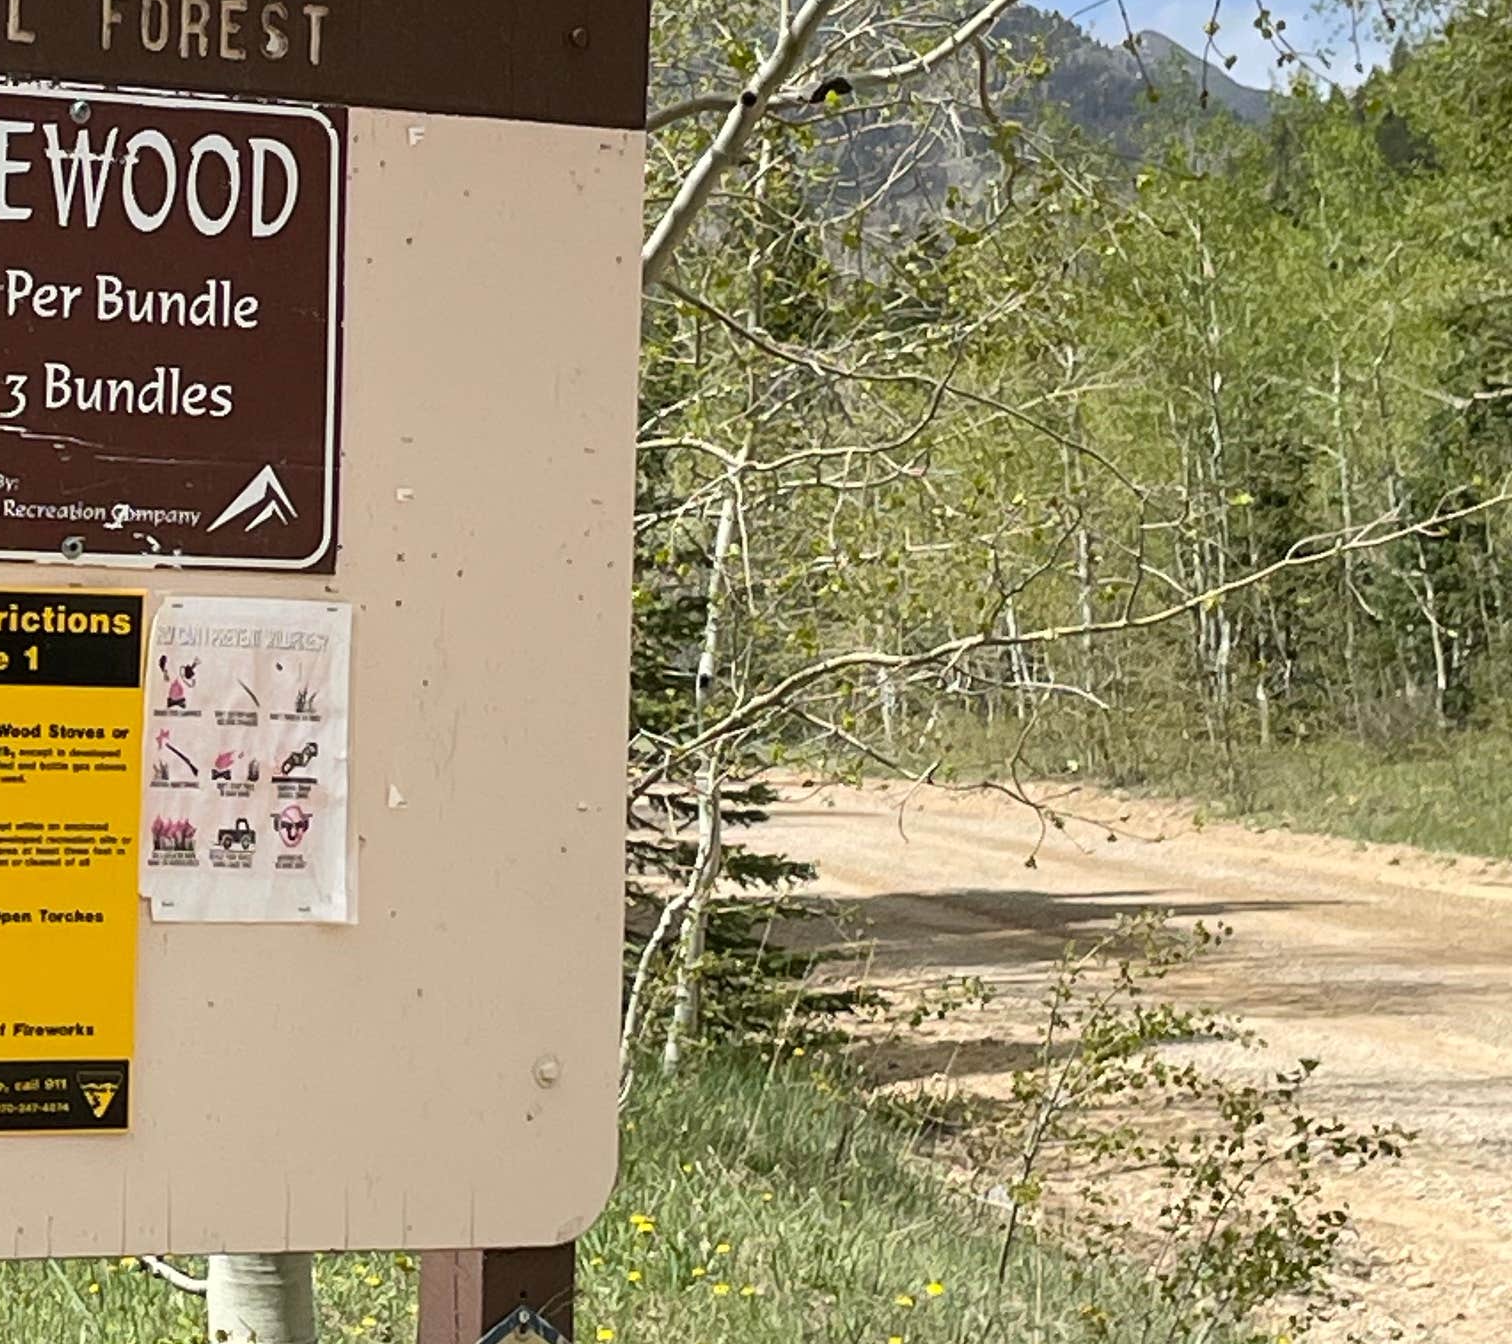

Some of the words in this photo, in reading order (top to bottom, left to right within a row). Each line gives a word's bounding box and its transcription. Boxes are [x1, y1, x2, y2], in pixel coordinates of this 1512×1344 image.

[6, 269, 83, 319] Per
[96, 274, 259, 329] Bundle
[0, 371, 28, 419] 3
[44, 362, 234, 418] Bundles
[3, 499, 106, 521] Recreation
[23, 645, 39, 671] 1
[49, 724, 105, 739] Stoves
[112, 727, 129, 739] or
[39, 909, 104, 923] Torches
[12, 1022, 95, 1037] Fireworks
[14, 1079, 40, 1092] call
[44, 1078, 68, 1090] 911
